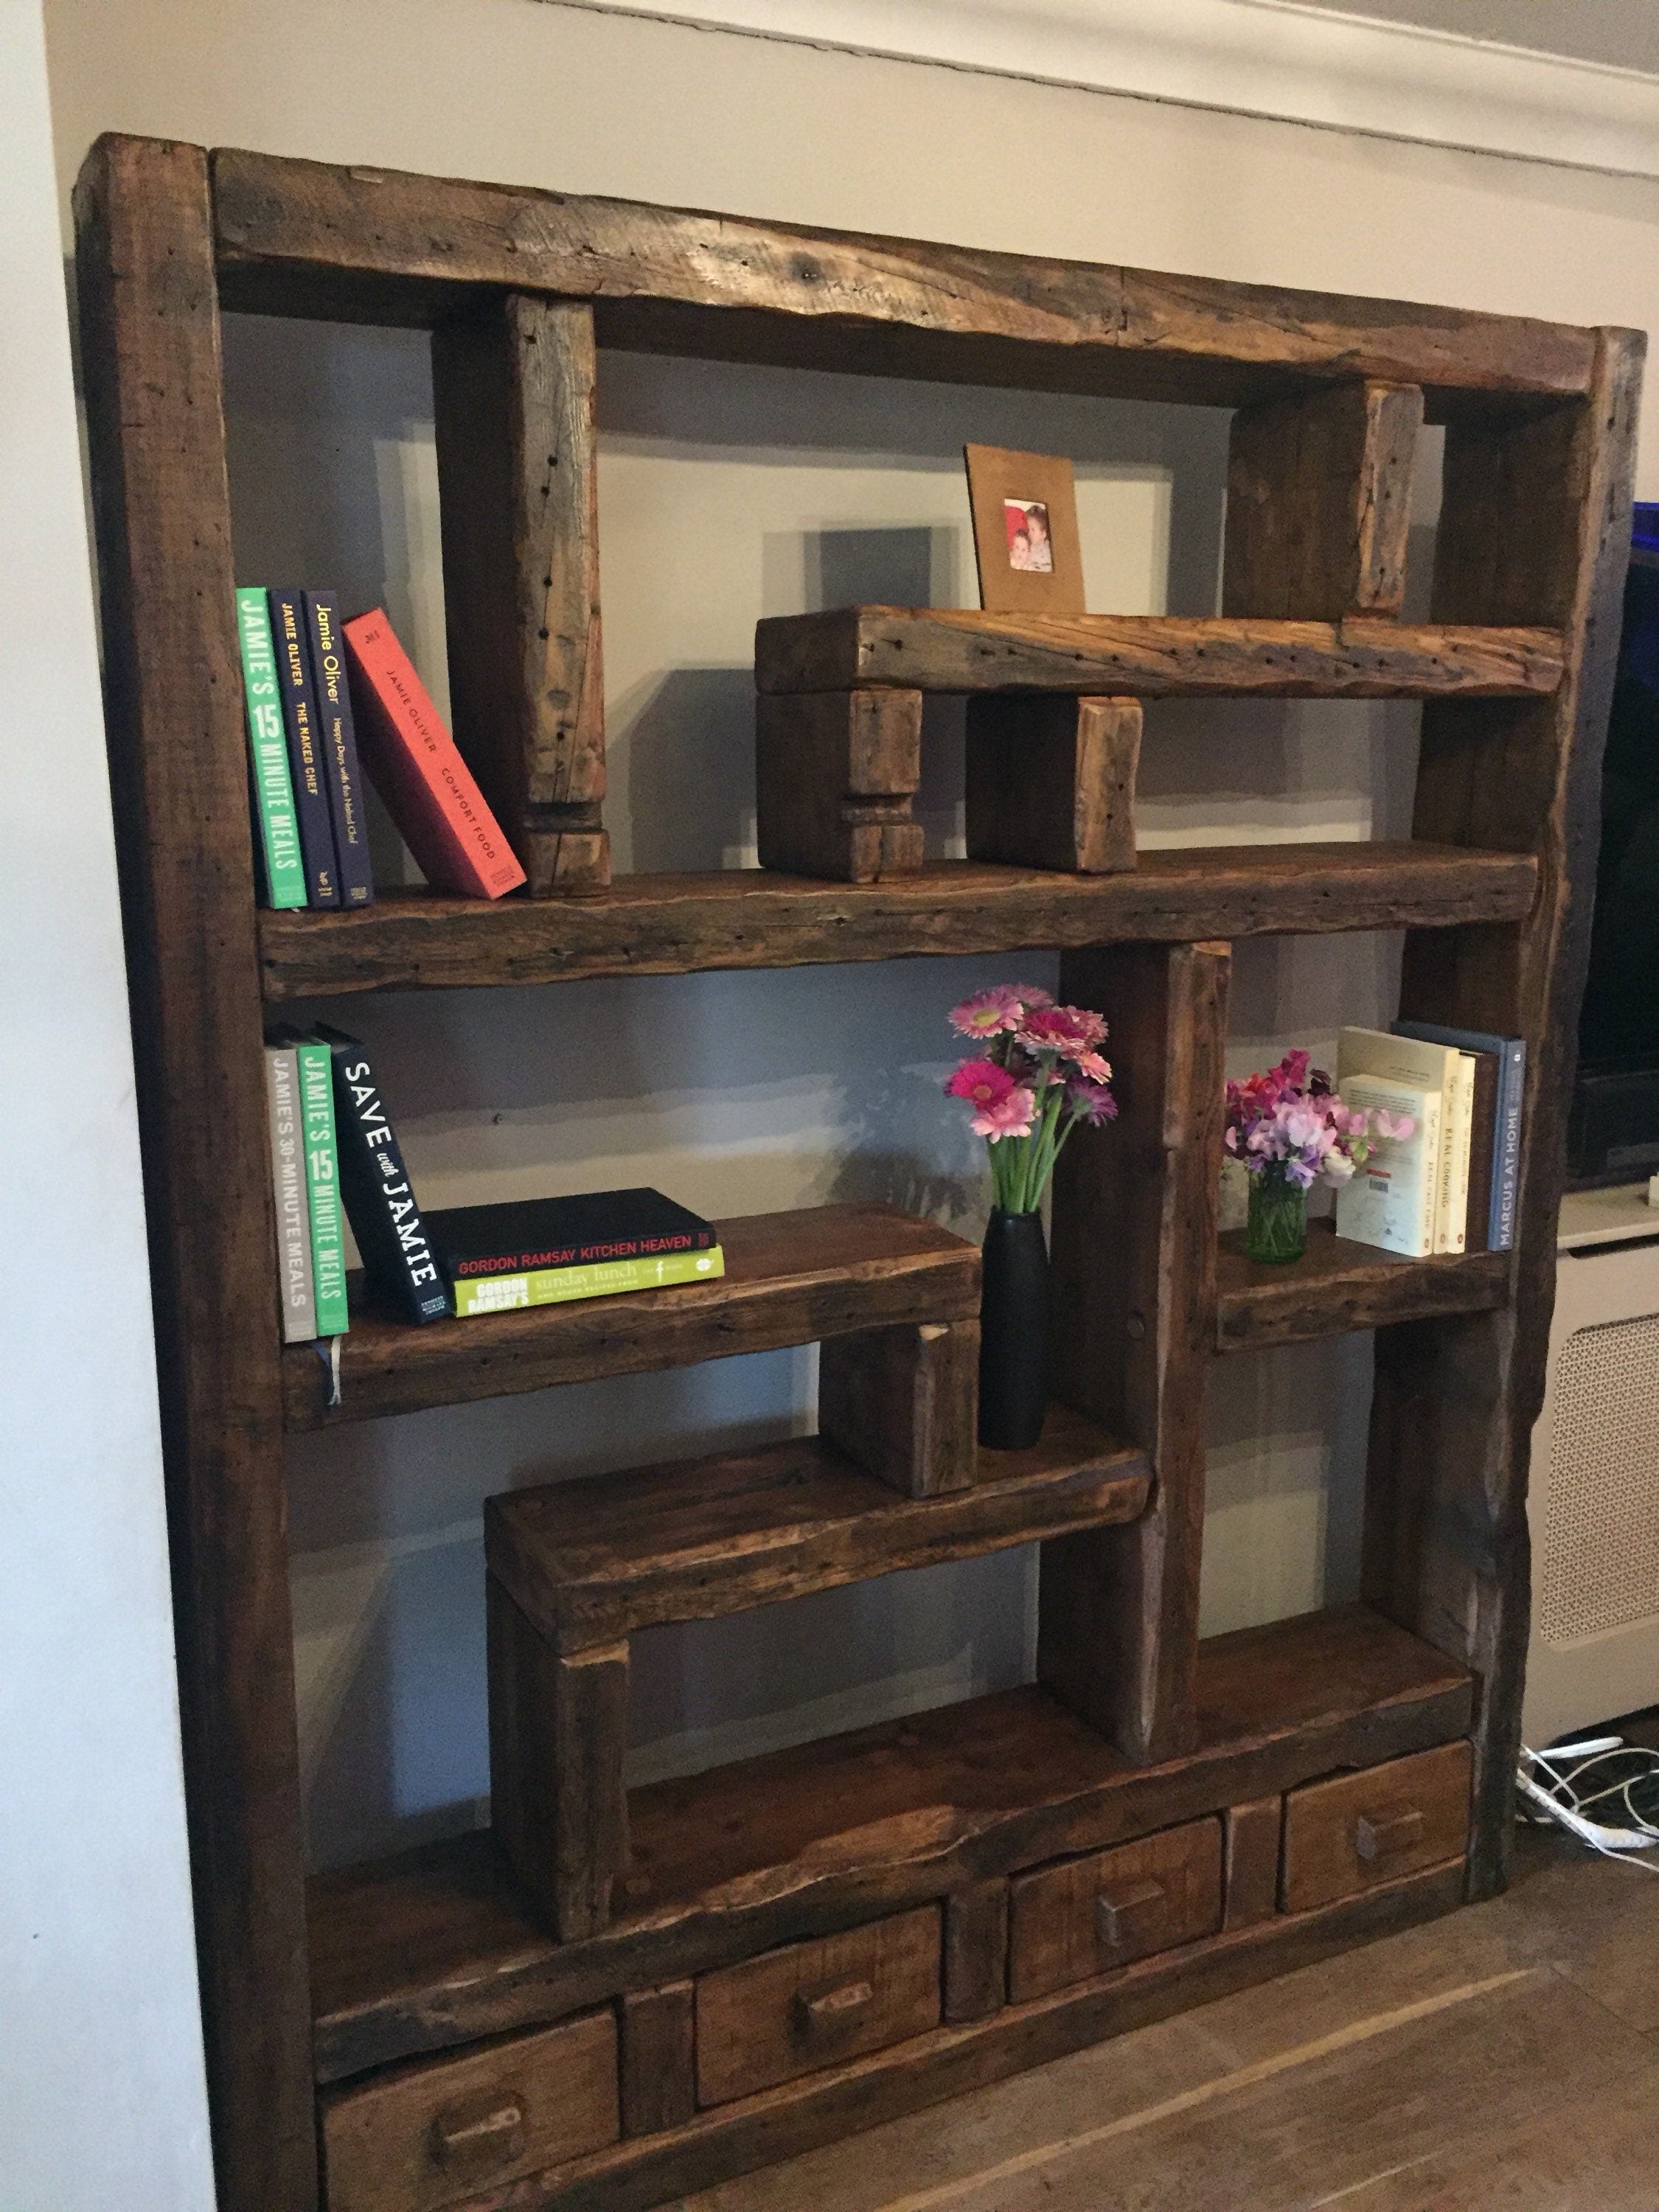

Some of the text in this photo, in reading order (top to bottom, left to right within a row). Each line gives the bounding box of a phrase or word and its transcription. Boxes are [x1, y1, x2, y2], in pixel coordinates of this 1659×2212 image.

[240, 599, 274, 695] JAMIE'S
[282, 602, 303, 686] JAMIE OLIVER
[316, 603, 341, 705] Jamie Oliver
[253, 704, 280, 739] 15
[333, 717, 343, 744] Happy
[386, 669, 437, 753] JAMIE OLIVER
[260, 743, 289, 808] MINUTE
[296, 701, 318, 796] THE NAKED CHEF
[336, 745, 346, 765] Days
[270, 815, 297, 869] MEALS
[441, 768, 495, 860] COMFORT FOOD
[273, 1057, 293, 1135] JAMIE'S
[305, 1056, 331, 1141] JAMIE'S
[345, 1062, 392, 1148] SAVE
[1506, 1107, 1518, 1152] HOME
[279, 1138, 302, 1239] 30-MINUTE
[309, 1149, 333, 1181] 15
[376, 1152, 400, 1178] with
[1504, 1157, 1515, 1175] AT
[313, 1184, 338, 1244] MINUTE
[383, 1182, 437, 1287] JAMIE
[1500, 1180, 1513, 1246] MARCUS
[287, 1242, 306, 1307] MEALS
[318, 1249, 341, 1300] MEALS
[458, 1256, 517, 1275] GORDON
[521, 1249, 576, 1267] RAMSAY
[580, 1242, 637, 1260] KITCHEN
[640, 1235, 692, 1254] HEAVEN
[535, 1262, 638, 1290] sunday lunch
[467, 1291, 529, 1315] RAMSAY'S
[476, 1278, 529, 1298] GORDON
